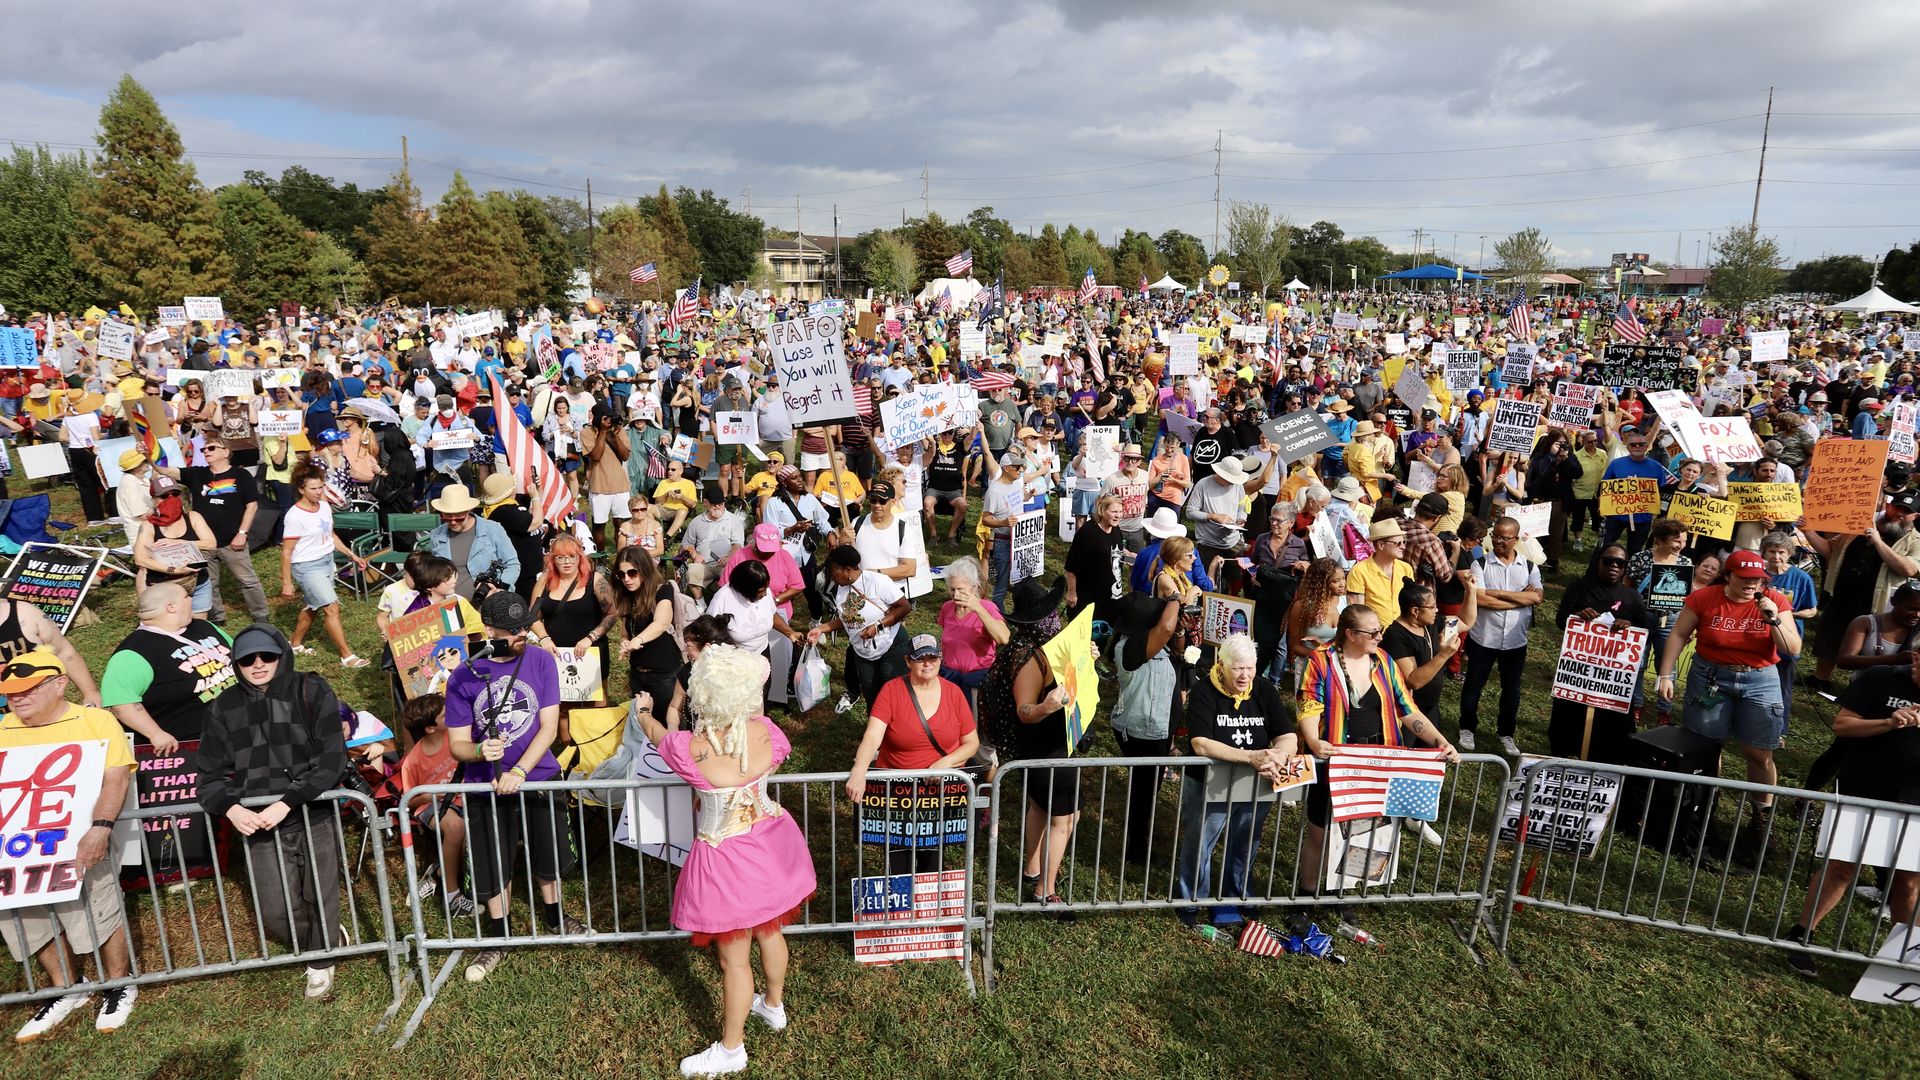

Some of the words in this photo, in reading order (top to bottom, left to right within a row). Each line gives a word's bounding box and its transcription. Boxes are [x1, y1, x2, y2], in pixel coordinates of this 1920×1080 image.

[772, 316, 837, 346] FAFO
[783, 346, 814, 363] Lose
[822, 338, 835, 355] it
[1448, 352, 1478, 363] DEFEND
[1507, 352, 1533, 360] NATIONAL
[1508, 358, 1530, 366] GUARD
[263, 369, 276, 381] NO
[781, 366, 807, 388] You
[811, 359, 837, 377] will
[1504, 370, 1529, 379] STREETS
[1623, 377, 1641, 387] NOT
[783, 384, 823, 414] Regret
[830, 382, 843, 401] it
[895, 396, 917, 413] Keep
[920, 389, 943, 405] Your
[1554, 396, 1594, 409] BILLIONAIRES
[1567, 391, 1584, 399] WITH
[1498, 399, 1513, 410] THE
[1513, 401, 1541, 415] PEOPLE
[1556, 404, 1568, 414] WE
[1569, 406, 1589, 417] NEED
[896, 411, 917, 424] Tiny
[1274, 413, 1314, 434] SCIENCE
[1495, 409, 1538, 429] UNITED
[1550, 412, 1591, 426] SOCIALISM
[890, 422, 907, 438] Off
[909, 418, 929, 431] Our
[1493, 424, 1505, 433] CAN
[1504, 426, 1524, 436] DEFEAT
[1524, 430, 1535, 439] THE
[1699, 422, 1738, 437] FOX
[893, 425, 938, 448] Democracy
[1286, 431, 1328, 452] CONSPIRACY
[1703, 444, 1761, 461] FACISM
[1817, 441, 1843, 457] THERE
[1847, 444, 1857, 454] IS
[1858, 445, 1867, 455] A
[1855, 457, 1876, 467] AND
[1600, 479, 1625, 495] RACE
[1626, 479, 1638, 493] IS
[1638, 480, 1656, 493] NOT
[1728, 485, 1763, 495] IMAGINE
[1611, 493, 1656, 506] PROBABLE
[1674, 493, 1707, 509] TRUMP
[1707, 500, 1736, 516] GIVES
[1739, 494, 1798, 505] IMMIGRANTS
[1616, 504, 1649, 514] CAUSE
[1689, 508, 1711, 517] SMALL
[1735, 511, 1795, 521] PEDOPHILES
[1015, 516, 1044, 539] DEFEND
[1024, 546, 1034, 558] TIME
[27, 559, 48, 572] WE
[1016, 559, 1021, 569] A
[22, 569, 45, 578] BLACK
[18, 576, 31, 584] NO
[32, 578, 59, 587] HUMAN
[12, 583, 40, 595] LOVE
[41, 587, 52, 597] IS
[52, 588, 80, 598] LOVE
[1651, 594, 1687, 603] DEMOCRAC
[43, 604, 50, 612] IS
[51, 605, 70, 614] REAL
[388, 602, 442, 641] REJECT
[1222, 607, 1230, 640] NEAUX
[1567, 618, 1646, 643] FIGHT
[393, 624, 441, 658] FALSE
[1567, 630, 1642, 663] TRUMP'S
[1563, 650, 1637, 673] AGENDA
[1558, 658, 1591, 677] MAKE
[1592, 664, 1612, 682] THE
[1613, 671, 1634, 686] U.S.
[1556, 671, 1632, 699] UNGOVERNABLE
[1216, 714, 1265, 727] Whatever
[0, 744, 82, 793] LO
[140, 757, 185, 772] KEEP
[152, 773, 198, 789] THAT
[139, 787, 197, 804] LITTLE
[861, 795, 898, 809] HOPE
[900, 797, 939, 810] OVER
[943, 796, 968, 808] FEA
[0, 783, 76, 831] VE
[0, 829, 69, 859] OT
[882, 927, 911, 938] SCIENCE
[914, 927, 921, 936] IS
[866, 938, 888, 946] PEOPLE
[888, 943, 907, 953] WHERE
[908, 941, 919, 951] YOU
[920, 941, 931, 950] CAN
[932, 940, 940, 949] BE
[913, 951, 928, 961] KIND
